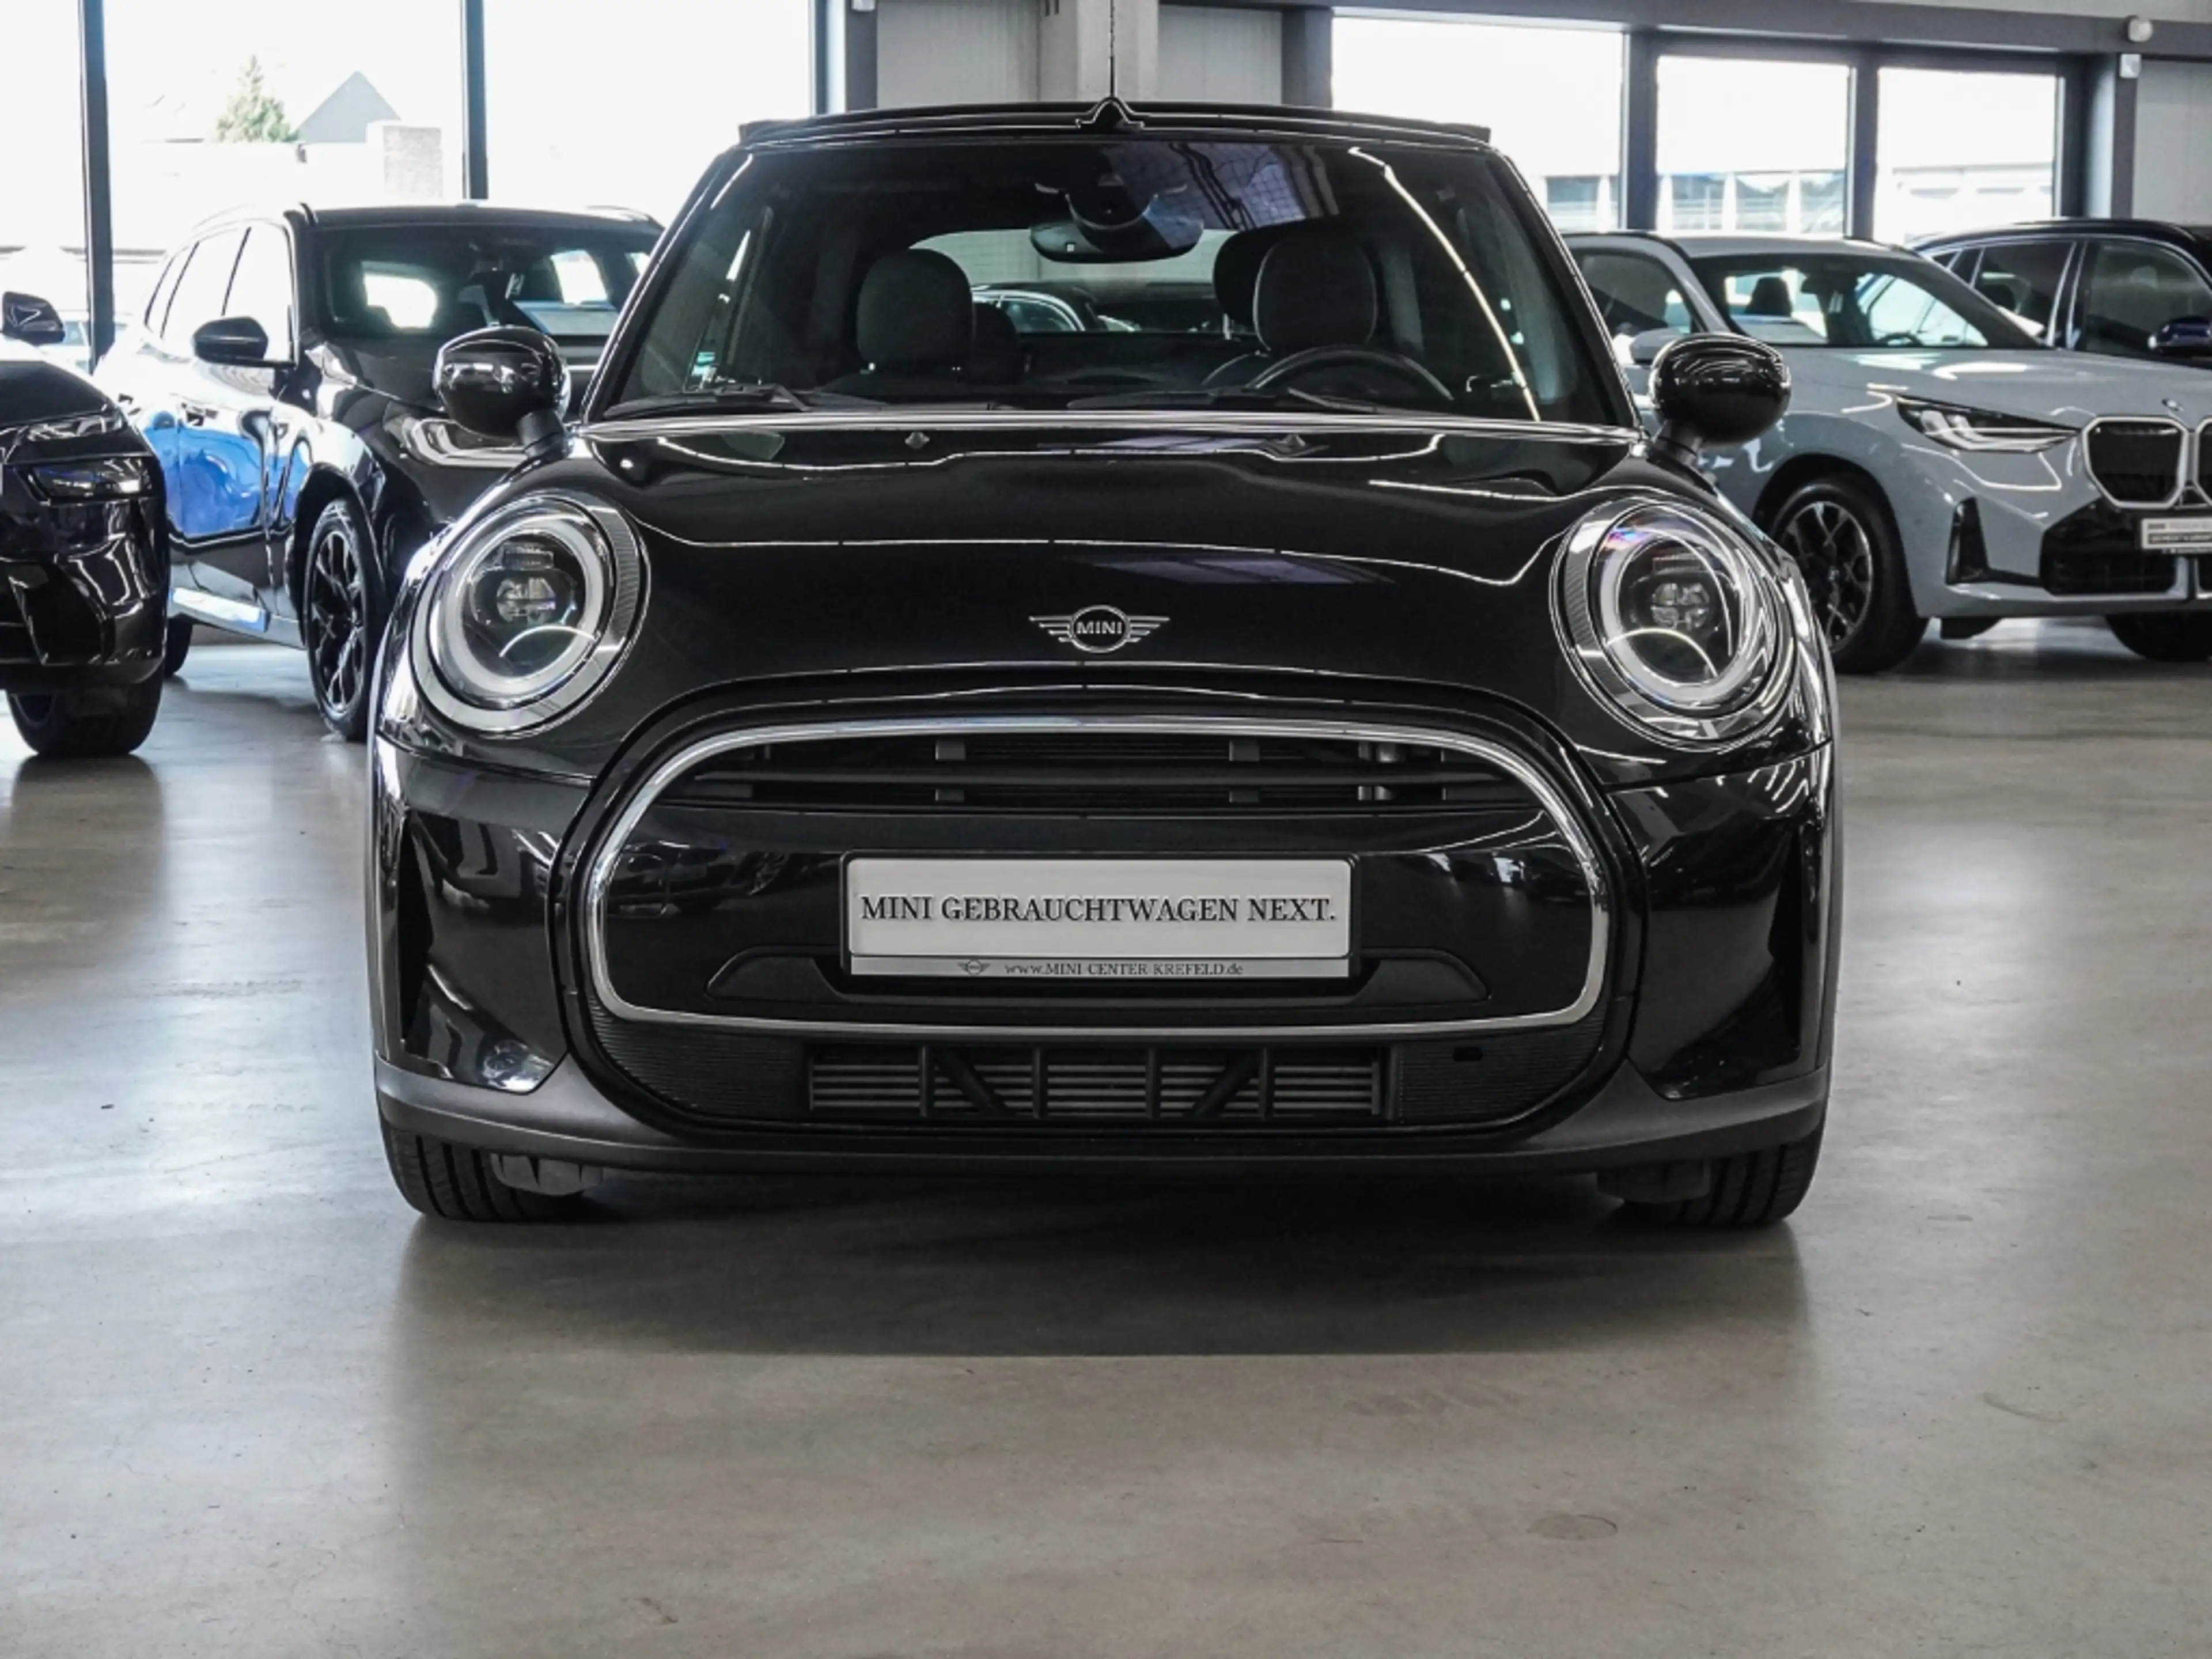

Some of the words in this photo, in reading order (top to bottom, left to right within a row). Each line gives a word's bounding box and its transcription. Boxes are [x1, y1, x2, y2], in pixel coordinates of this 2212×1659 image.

[1076, 621, 1121, 634] MINI
[861, 897, 933, 920] MINI
[941, 897, 1238, 921] GEBRAUCHTWAGEN
[1247, 898, 1336, 921] NEXT.
